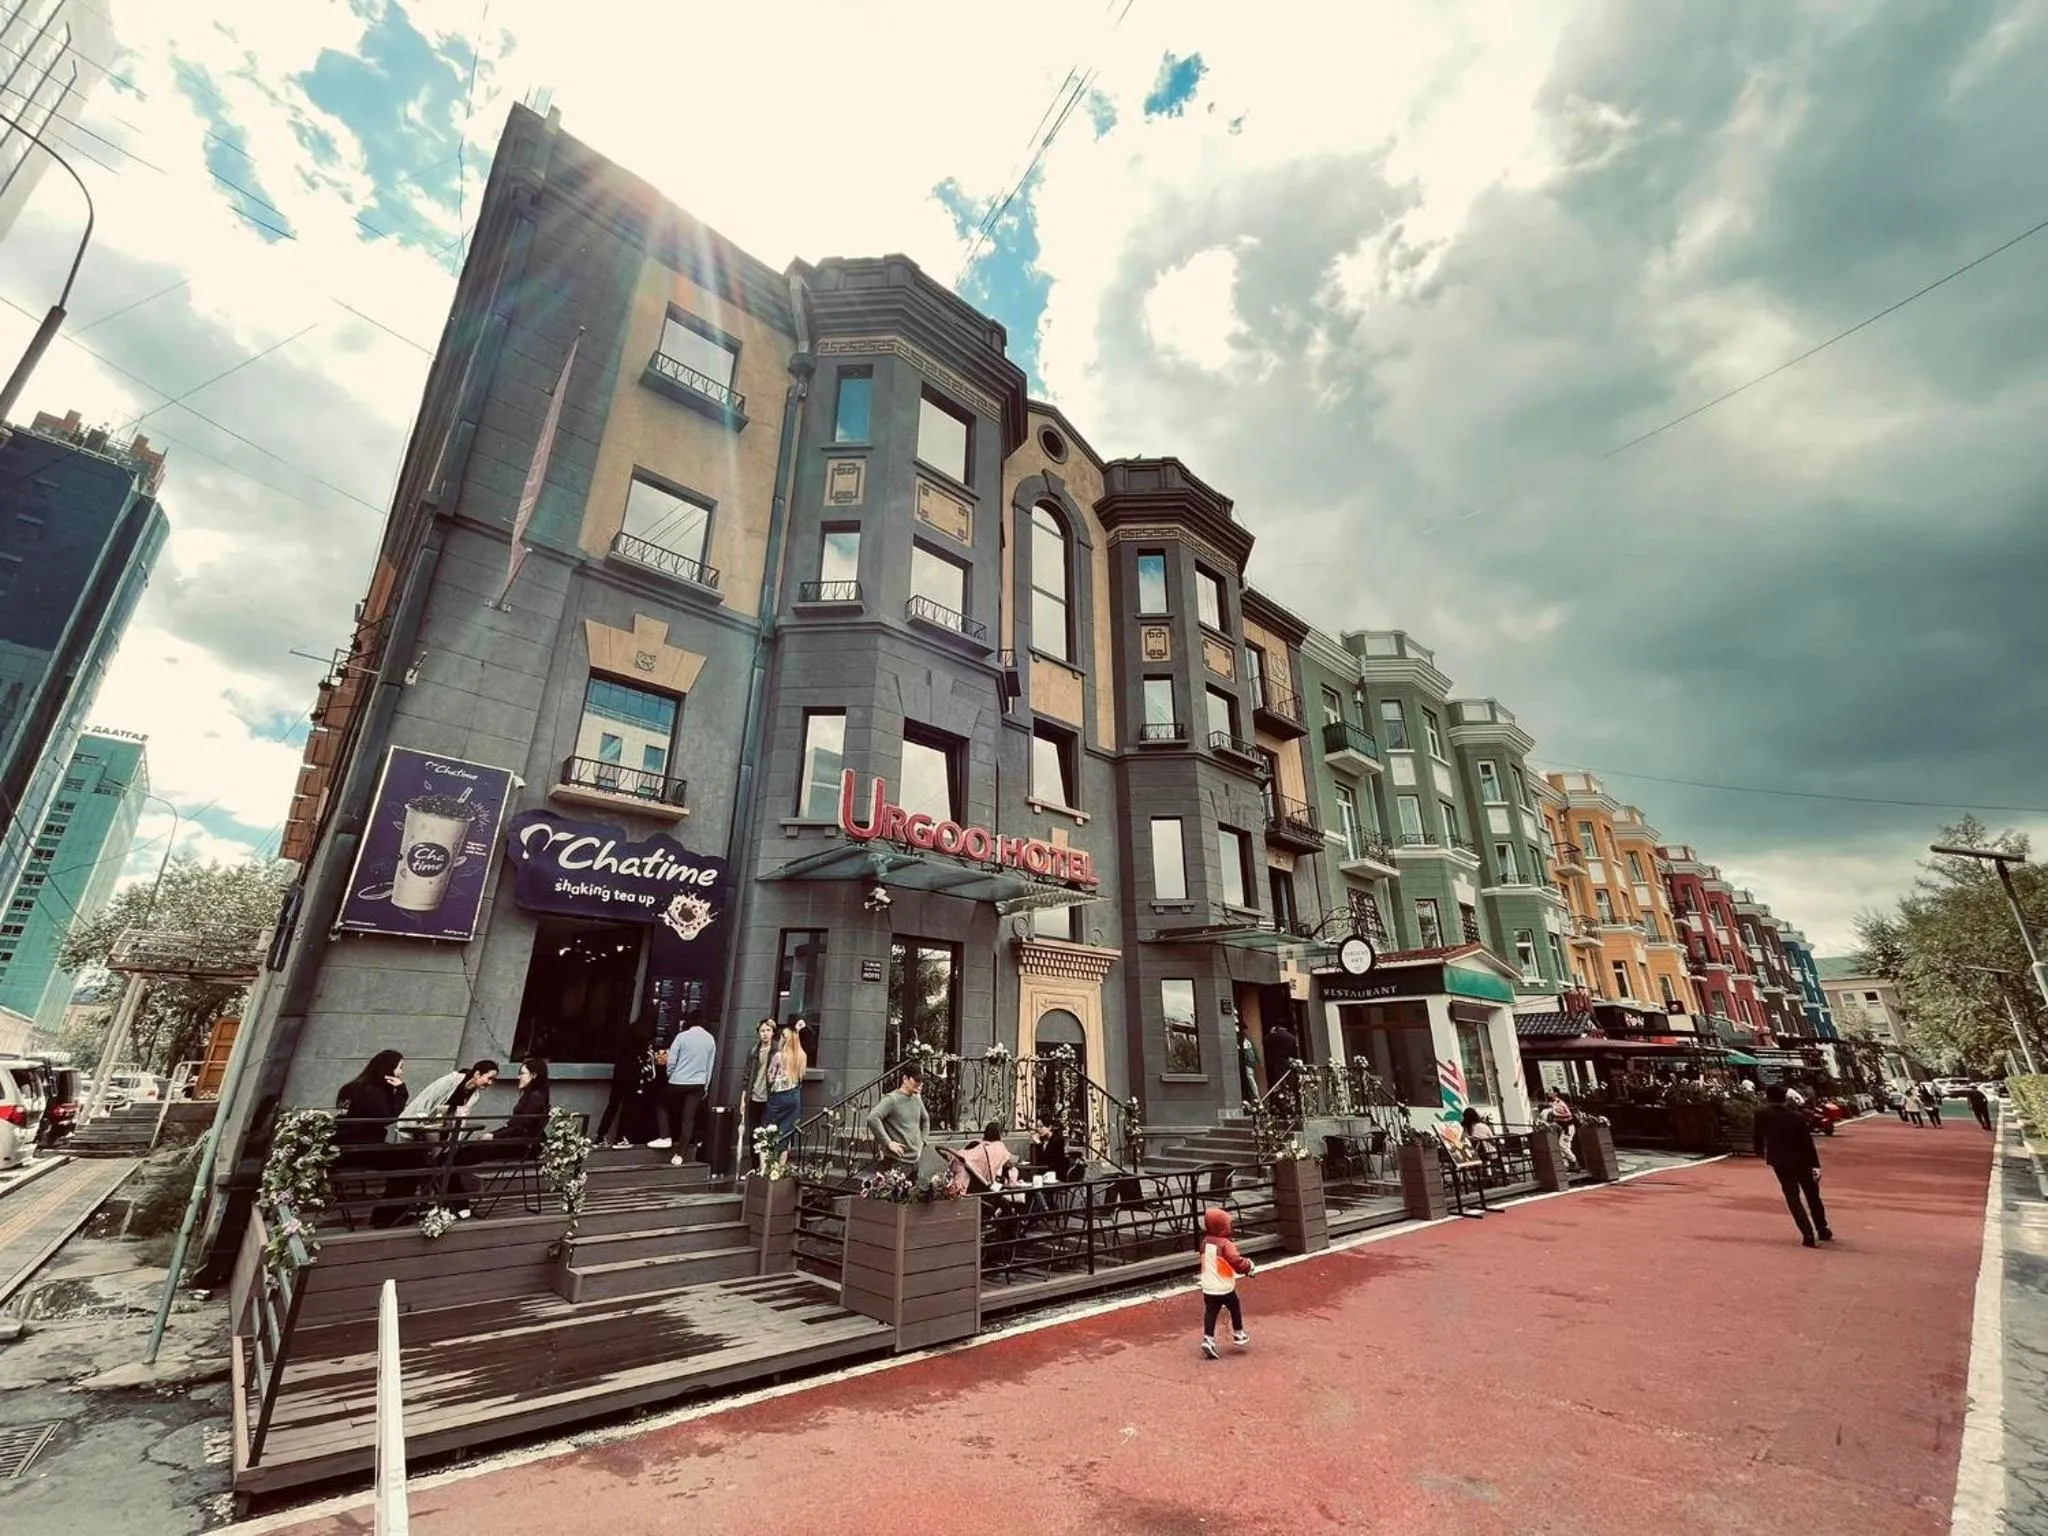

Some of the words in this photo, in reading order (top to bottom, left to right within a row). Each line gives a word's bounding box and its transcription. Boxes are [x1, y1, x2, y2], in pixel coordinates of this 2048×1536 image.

[434, 765, 479, 780] Chatime
[839, 767, 993, 862] URGOO
[996, 833, 1100, 887] HOTEL
[413, 847, 445, 861] Cha
[557, 836, 719, 887] Chatime
[411, 859, 444, 872] time
[554, 878, 611, 902] shaking
[613, 889, 637, 903] tea
[638, 894, 656, 907] up
[1323, 984, 1398, 999] RESTAURANT
